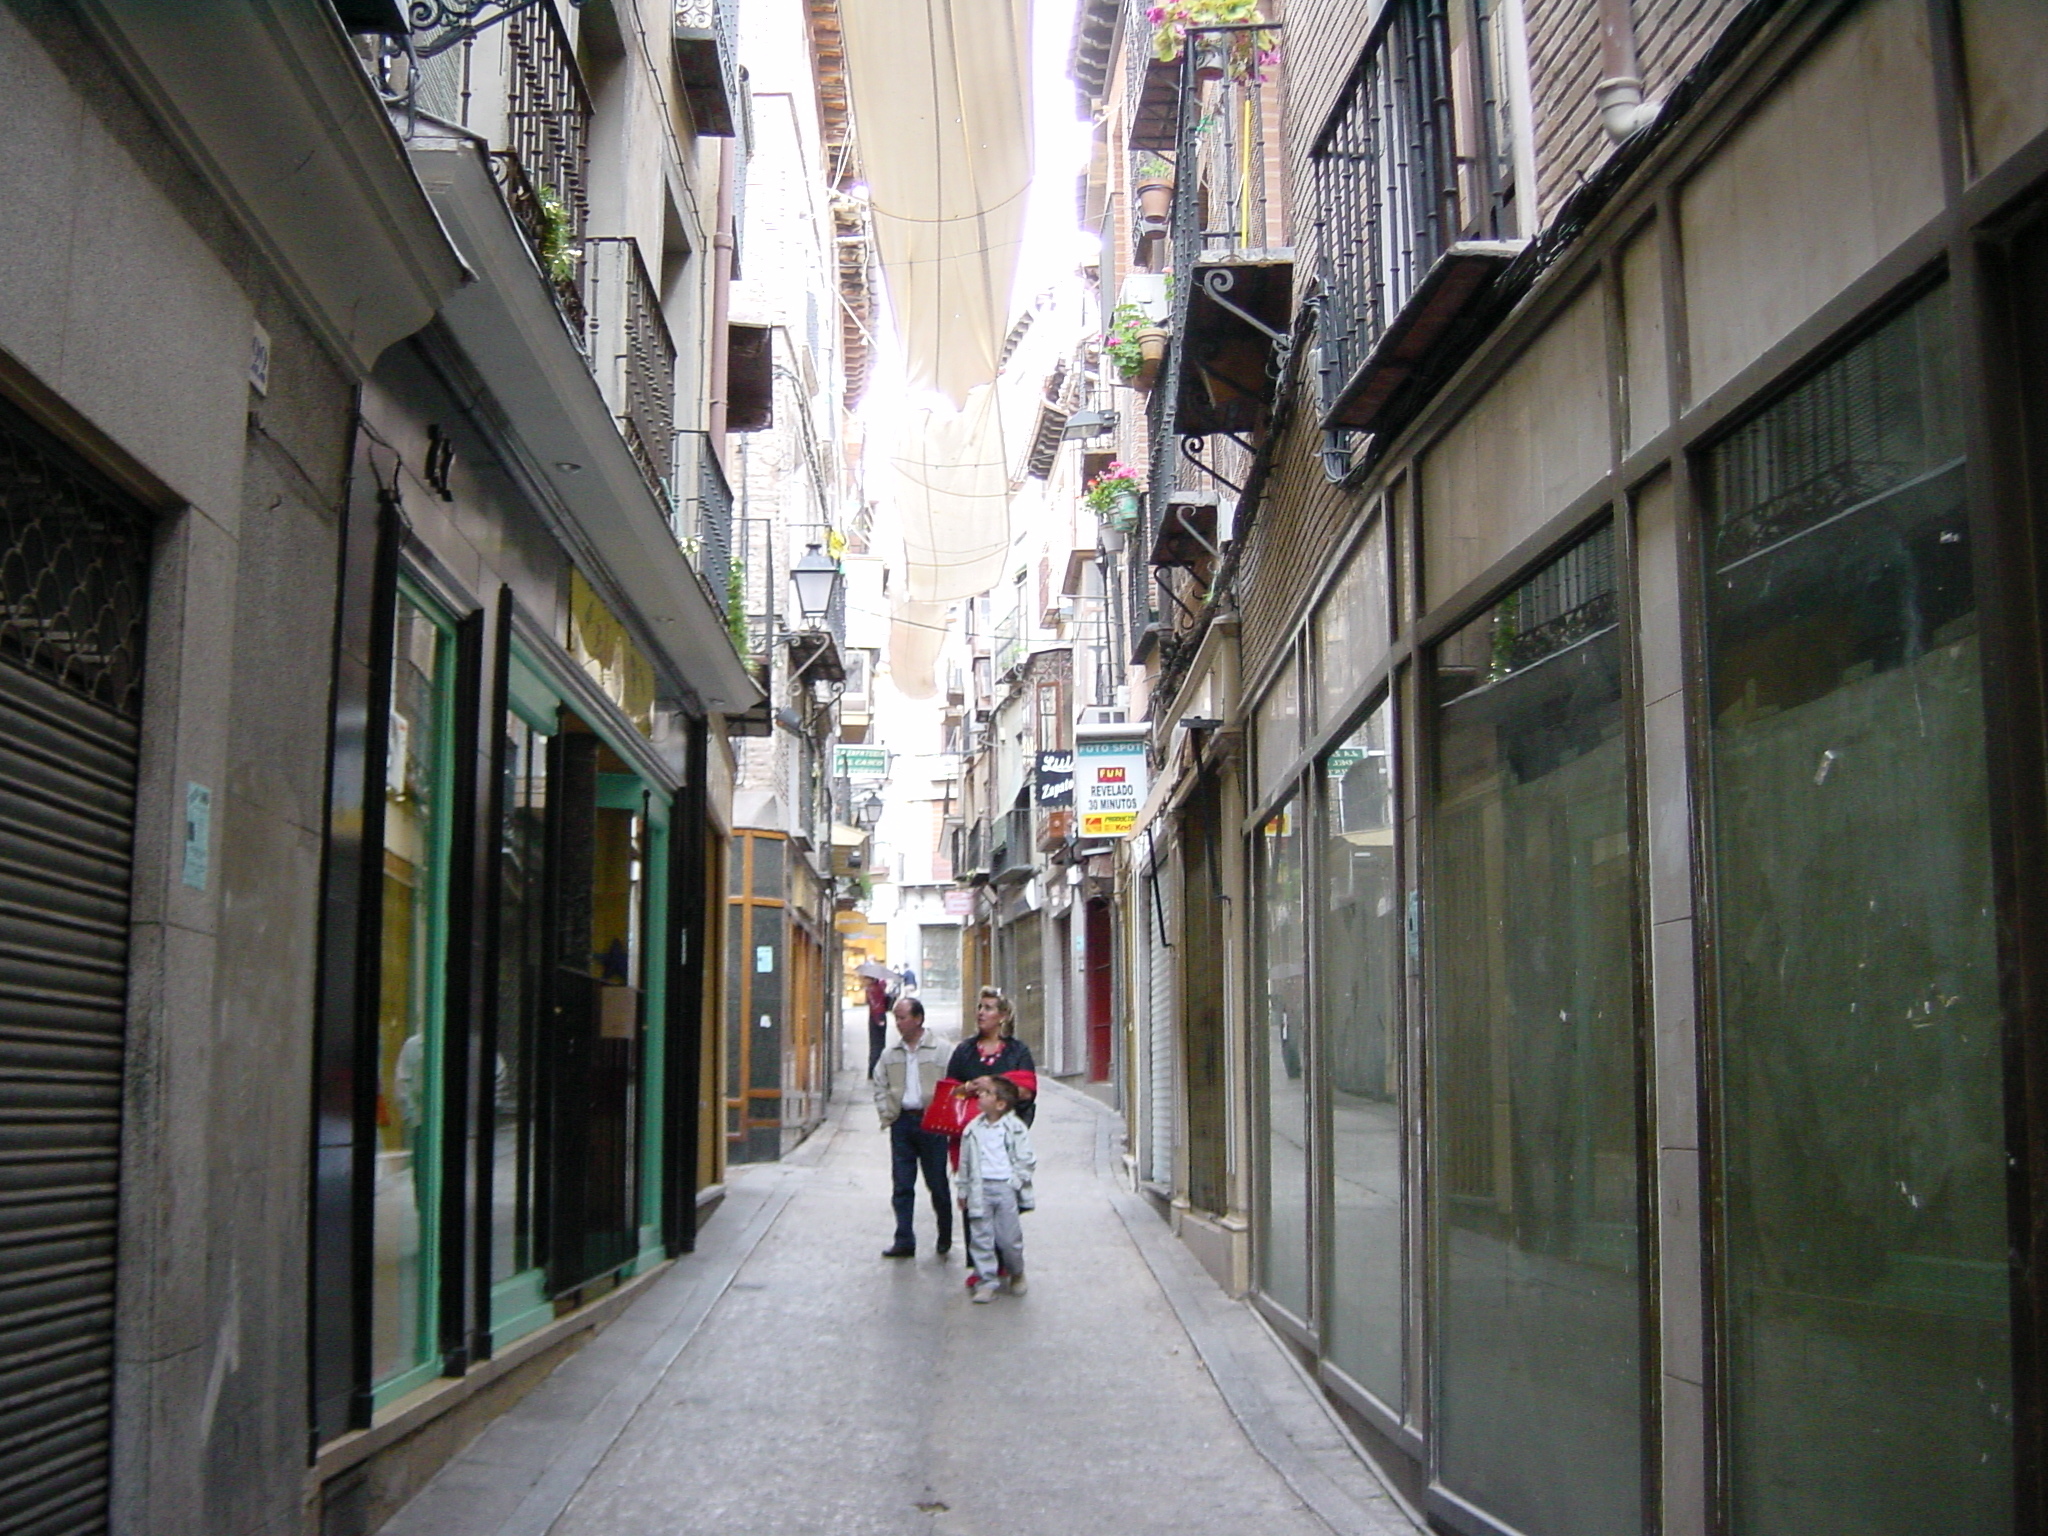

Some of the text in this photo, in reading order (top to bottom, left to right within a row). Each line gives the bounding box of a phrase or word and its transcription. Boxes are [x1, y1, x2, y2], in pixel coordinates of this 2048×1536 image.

[1079, 743, 1141, 753] FOTO SPOT
[1099, 768, 1123, 778] FUN
[1091, 785, 1133, 797] REVELADO
[1088, 798, 1137, 811] 30 MINUTOS
